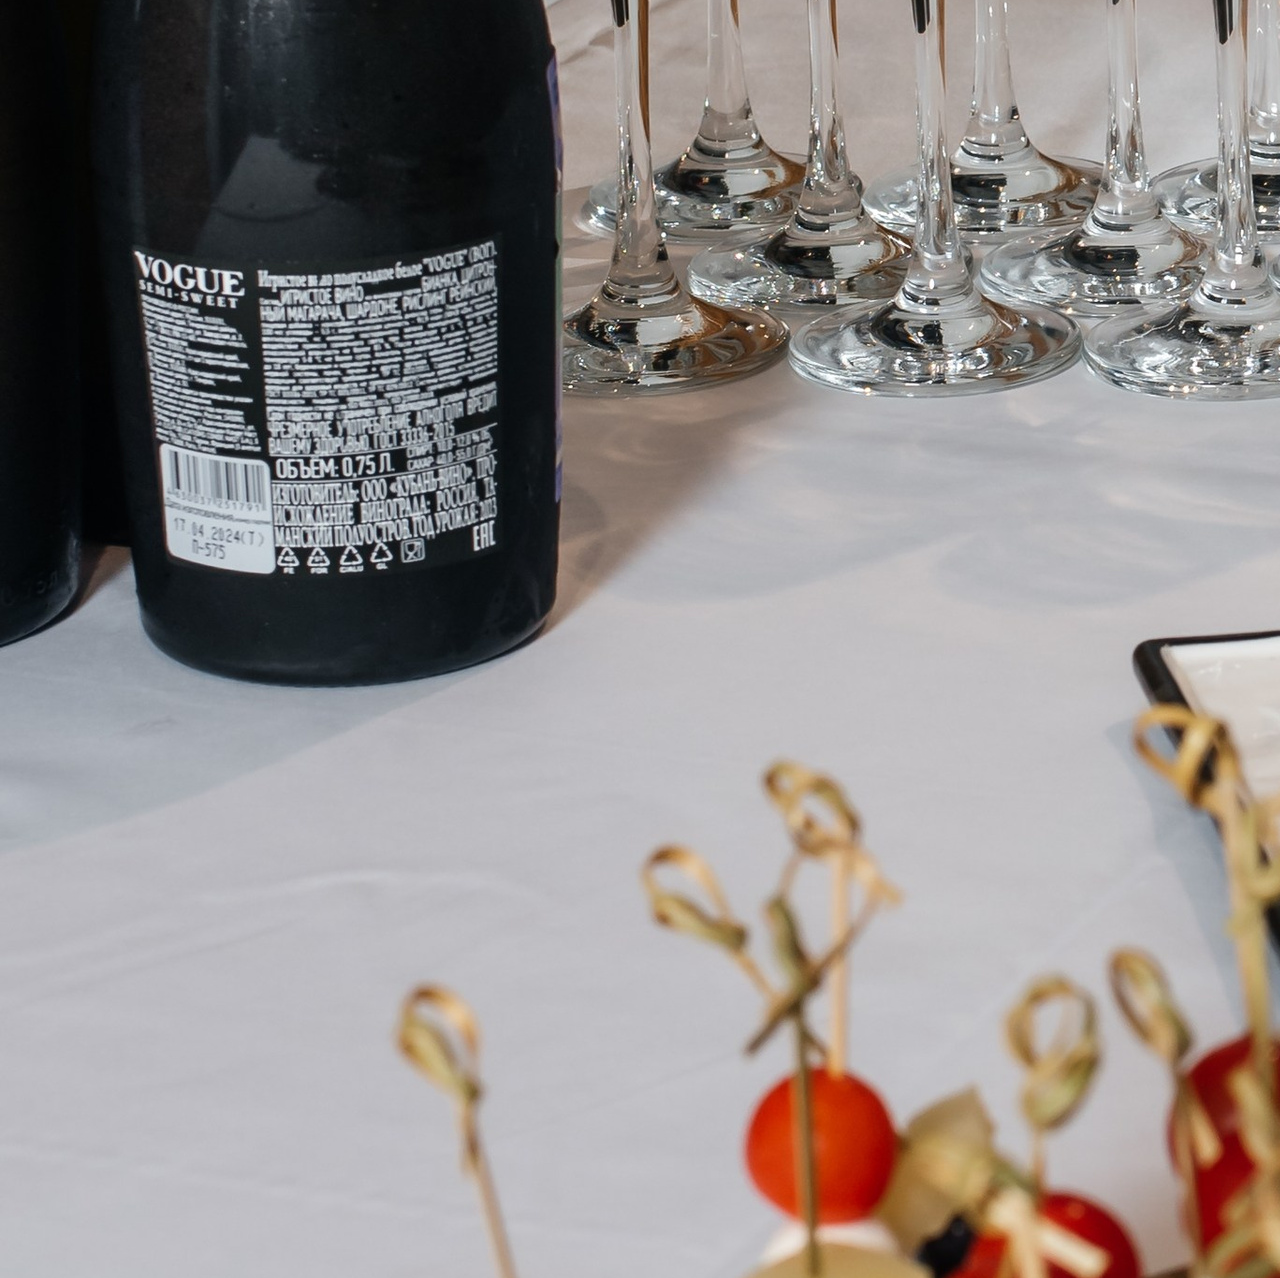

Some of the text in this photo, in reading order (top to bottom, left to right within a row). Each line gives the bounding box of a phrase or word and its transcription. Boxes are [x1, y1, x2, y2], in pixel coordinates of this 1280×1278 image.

[134, 250, 245, 296] VOGUE
[138, 279, 239, 309] SEMI-SWEET
[280, 288, 333, 305] ИГРИСТОЕ
[334, 286, 365, 304] ВИНО
[287, 304, 345, 322] МАГАРАЧА,
[345, 297, 402, 319] ШАРДОНЕ,
[402, 288, 448, 312] РИСЛИНГ
[267, 421, 333, 438] ЧРЕЗМЕРНОЕ
[336, 412, 411, 437] УПОТРЕБЛЕНИЕ
[415, 401, 464, 426] АЛКОГОЛЯ
[268, 437, 312, 454] ВАШЕМУ
[373, 430, 397, 449] ГОСТ
[400, 420, 455, 446] 33336-2015
[272, 482, 359, 505] ИЗГОТОВИТЕЛЬ:
[361, 478, 388, 502] ООО
[475, 454, 498, 479] ПРО-
[342, 454, 376, 478] 0,75
[379, 452, 395, 474] Л.
[360, 495, 431, 523] ВИНОГРАДА:
[274, 525, 334, 548] МАНСКИЙ
[412, 515, 436, 540] ГОД
